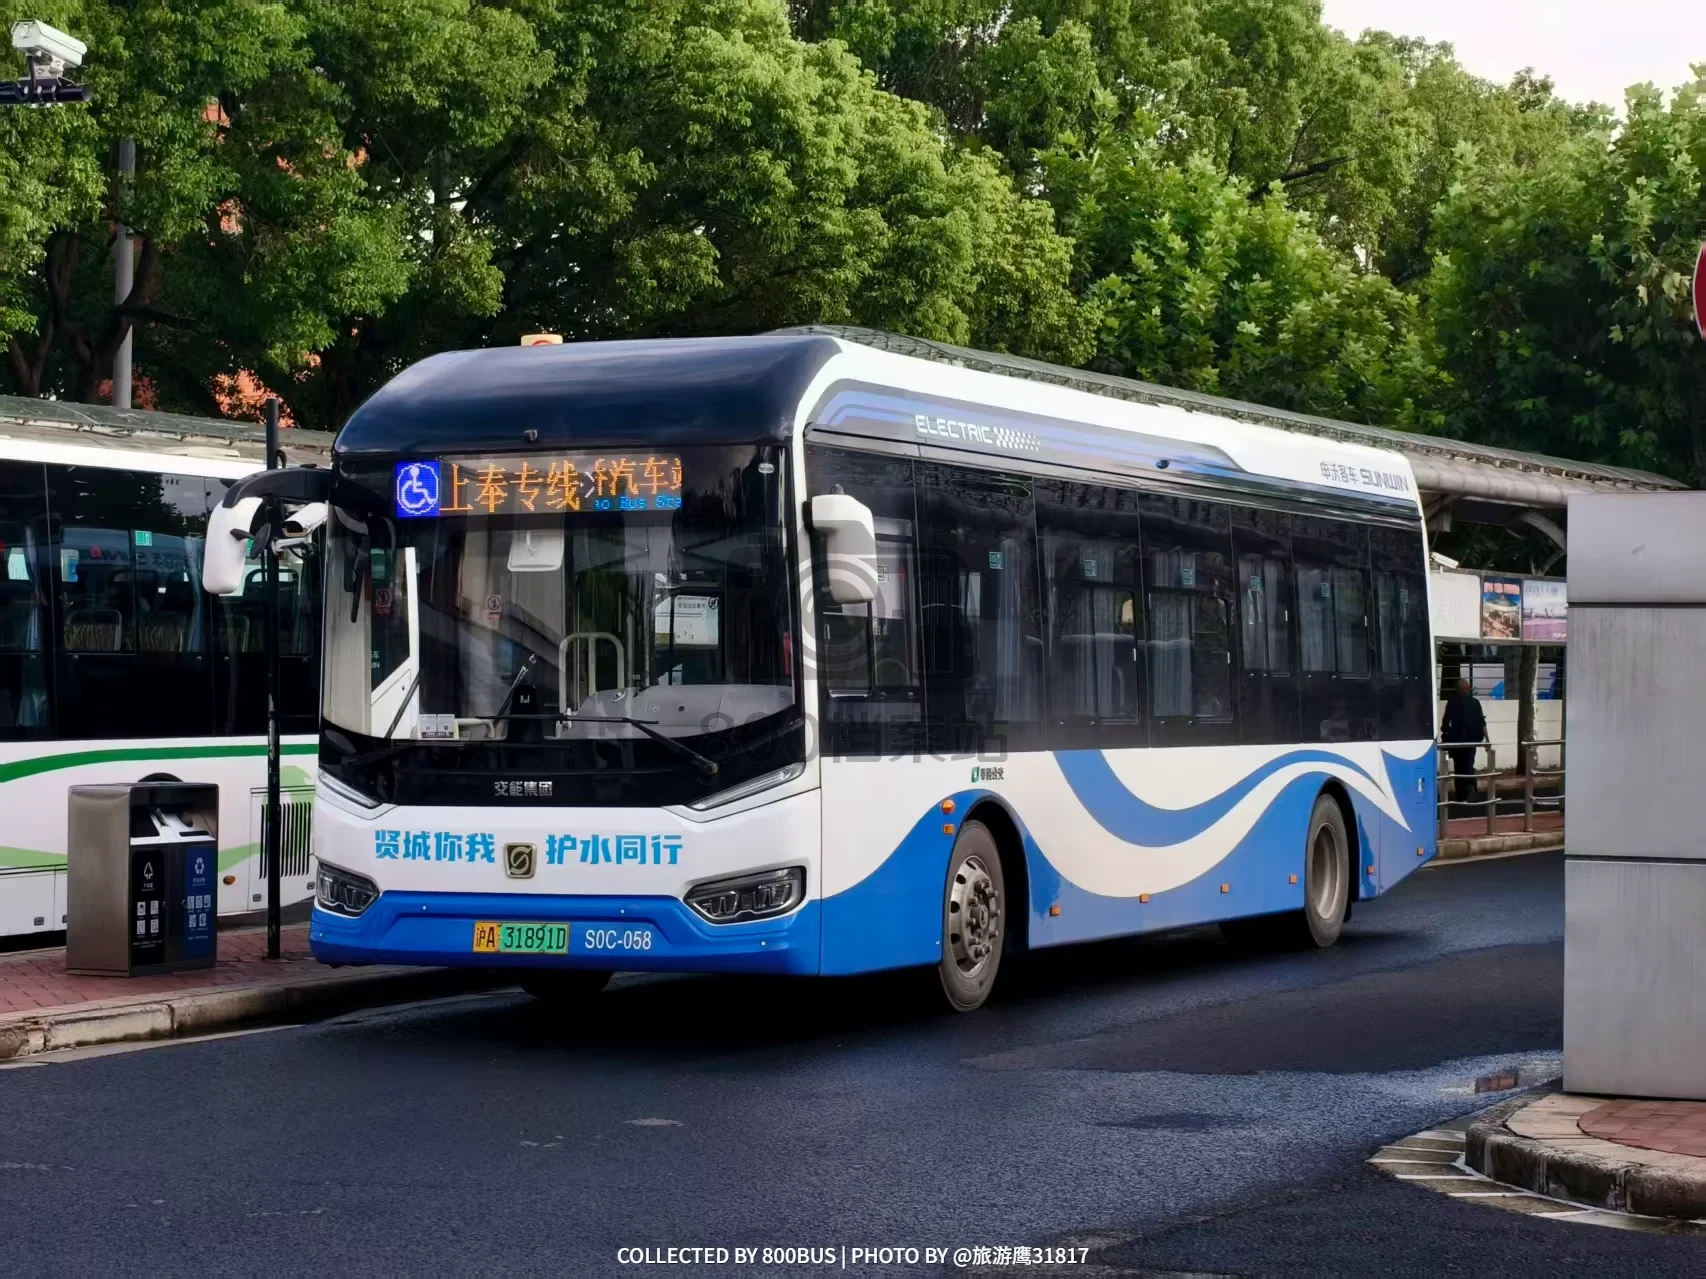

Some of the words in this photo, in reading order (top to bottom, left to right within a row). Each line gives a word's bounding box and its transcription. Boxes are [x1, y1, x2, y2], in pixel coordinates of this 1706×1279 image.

[915, 414, 993, 444] ELECTRIC
[440, 459, 580, 513] 上奉专线
[1320, 461, 1358, 485] 申沃客车
[1360, 468, 1409, 492] SUNWIN
[620, 496, 646, 509] Bus
[494, 780, 553, 797] 交能集团
[374, 829, 496, 864] 贤城你我
[546, 833, 684, 865] 护水同行
